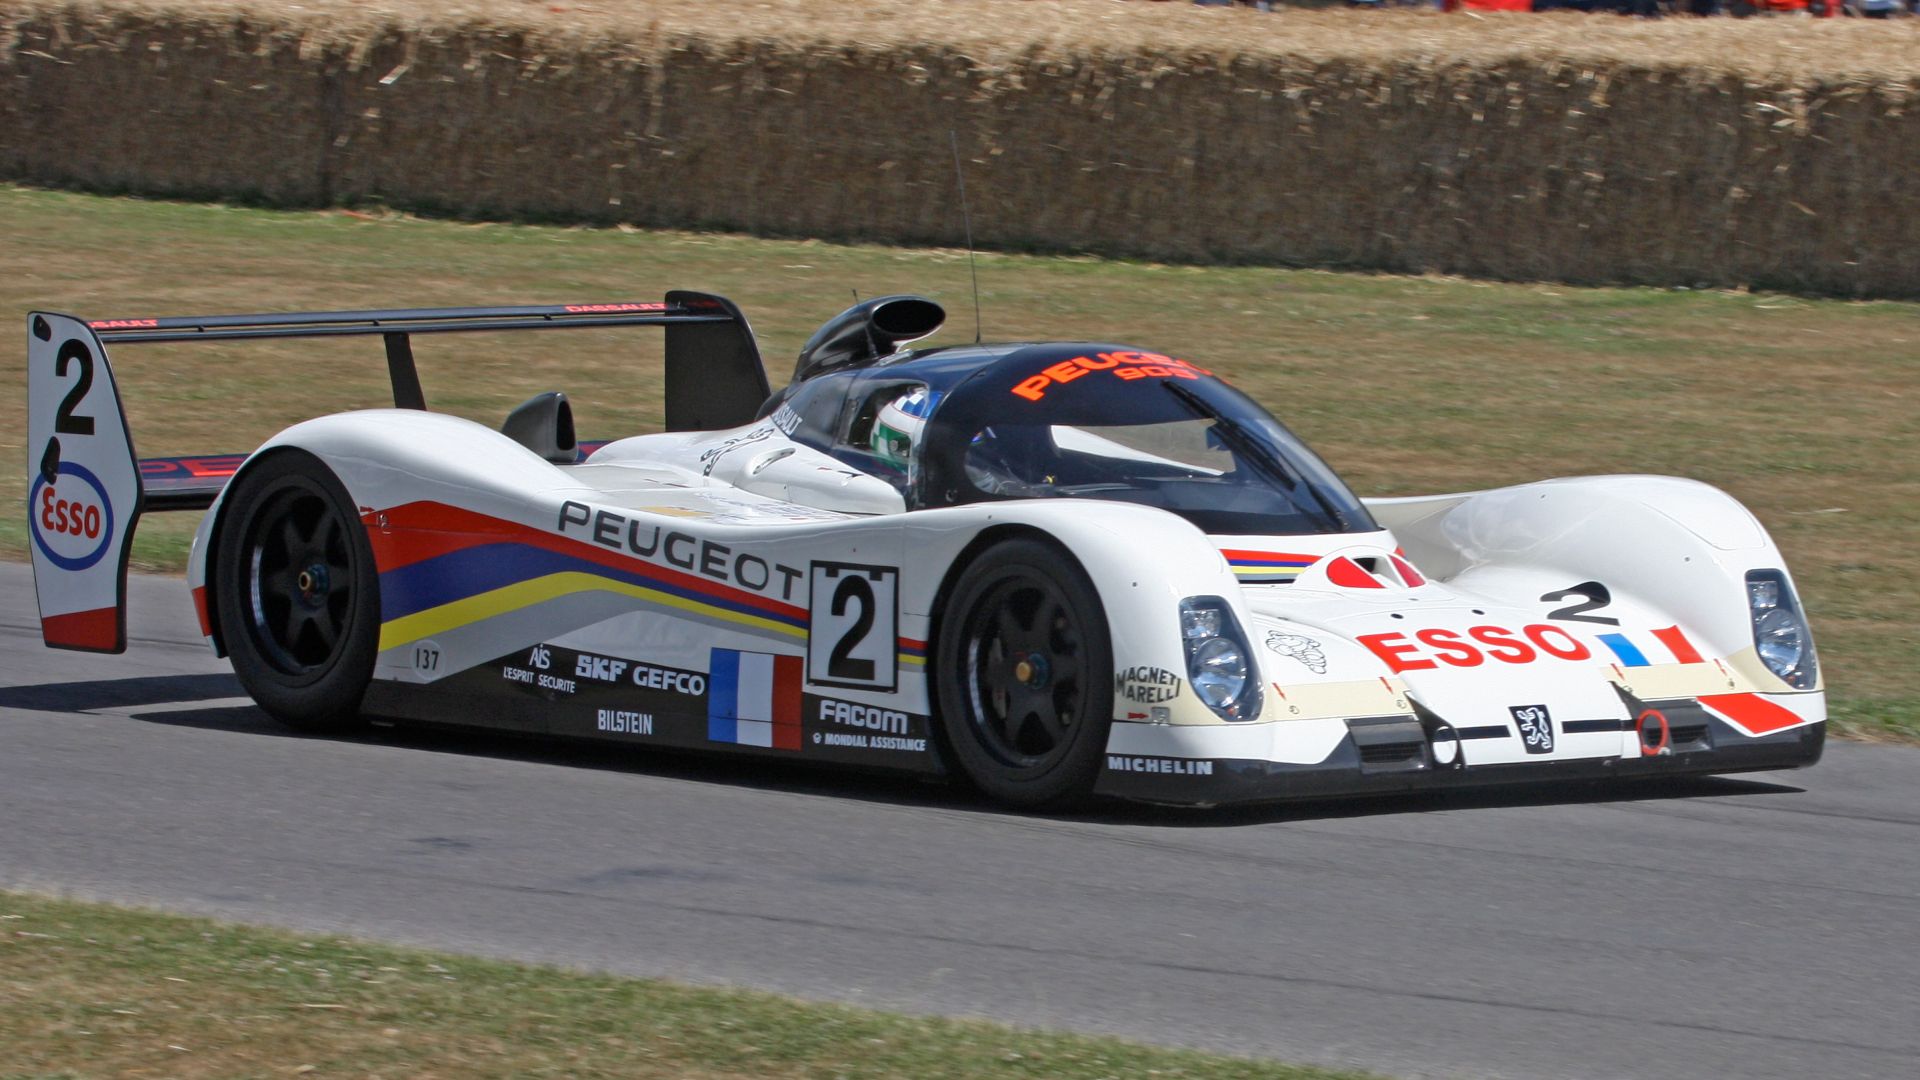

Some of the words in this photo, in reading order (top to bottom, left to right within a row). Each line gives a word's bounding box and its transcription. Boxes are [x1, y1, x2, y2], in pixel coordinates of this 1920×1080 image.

[55, 338, 95, 435] 2
[42, 486, 100, 539] ESSO
[558, 500, 803, 600] PEUGEOT
[1539, 581, 1621, 626] 2
[828, 574, 876, 681] 2
[416, 648, 439, 670] 137
[1355, 623, 1592, 675] ESSO
[538, 674, 575, 693] SECURITE
[575, 654, 627, 682] SKF
[633, 666, 705, 696] GEFCO
[598, 710, 652, 735] BILSTEIN
[820, 700, 908, 734] FACOM
[824, 733, 867, 747] MONDIAL
[870, 736, 926, 751] ASSISTANCE
[1108, 756, 1213, 775] MICHELIN
